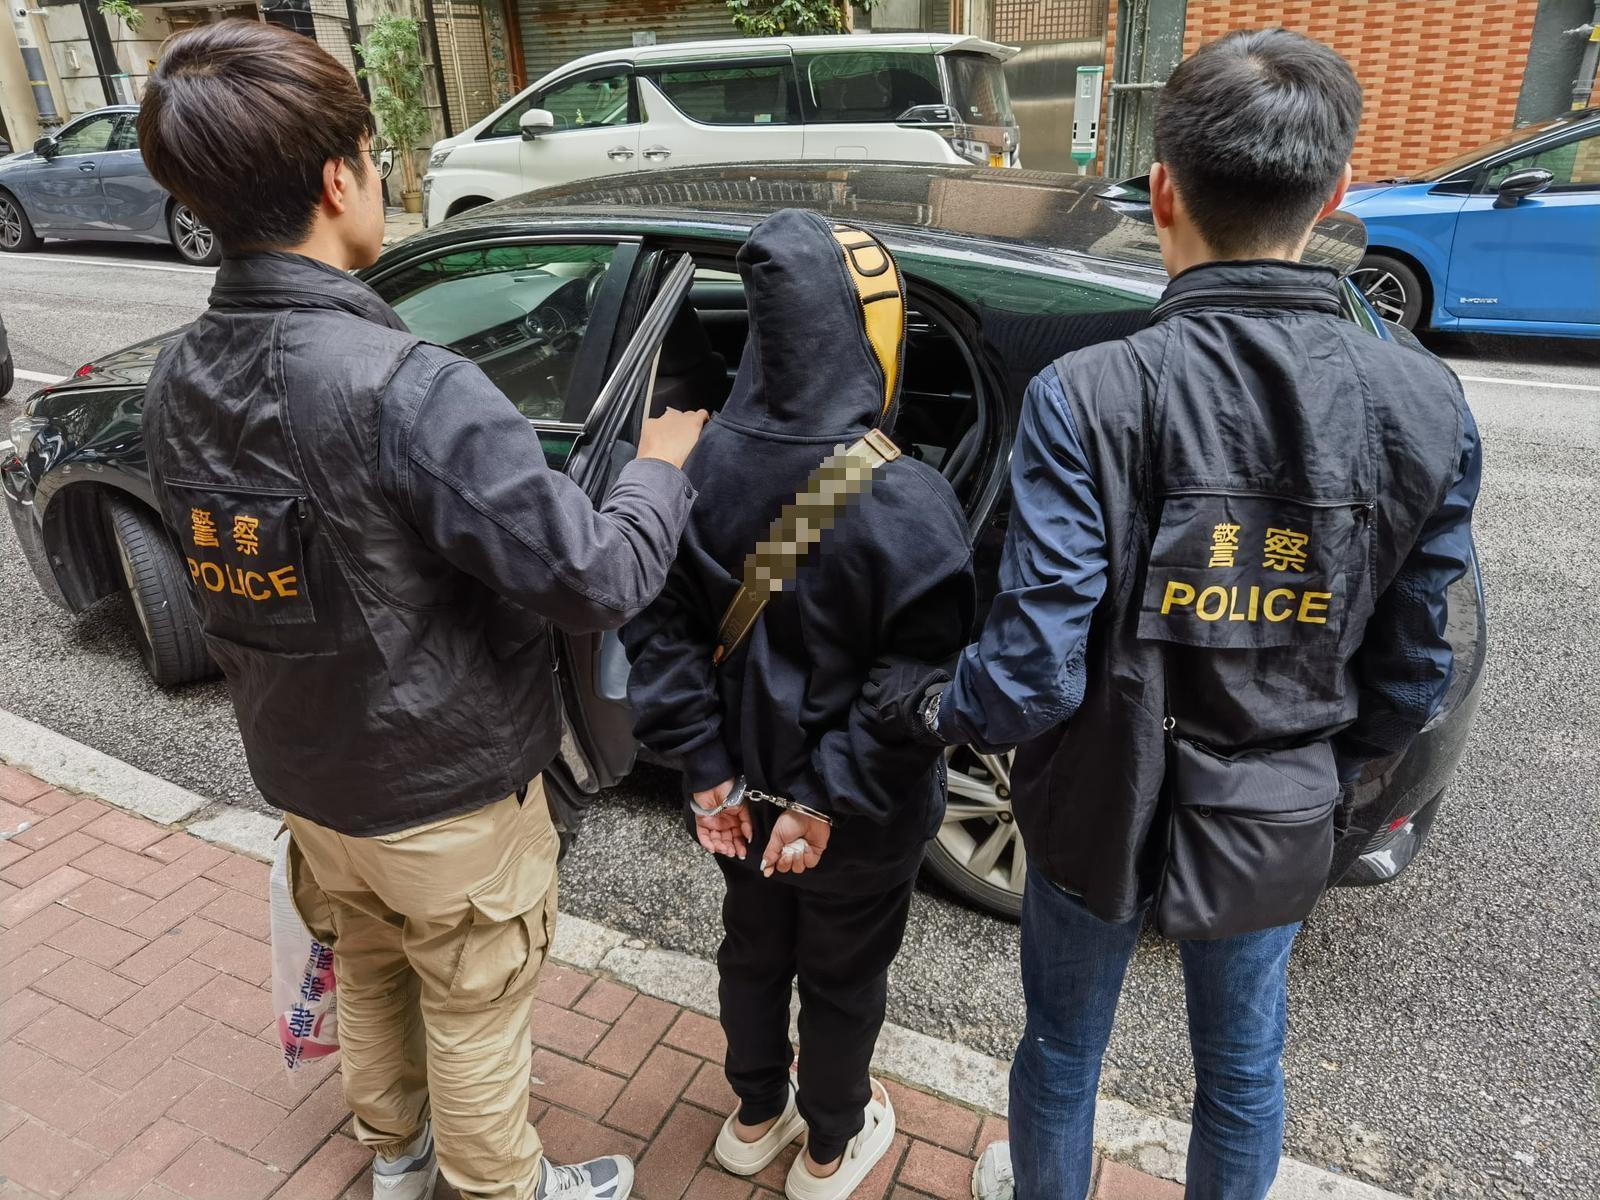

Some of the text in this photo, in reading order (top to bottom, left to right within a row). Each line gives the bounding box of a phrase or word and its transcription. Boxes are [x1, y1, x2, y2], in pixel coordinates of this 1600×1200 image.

[191, 507, 260, 556] 警察
[1208, 523, 1310, 573] 警察
[187, 557, 298, 601] POLICE
[1160, 580, 1332, 624] POLICE
